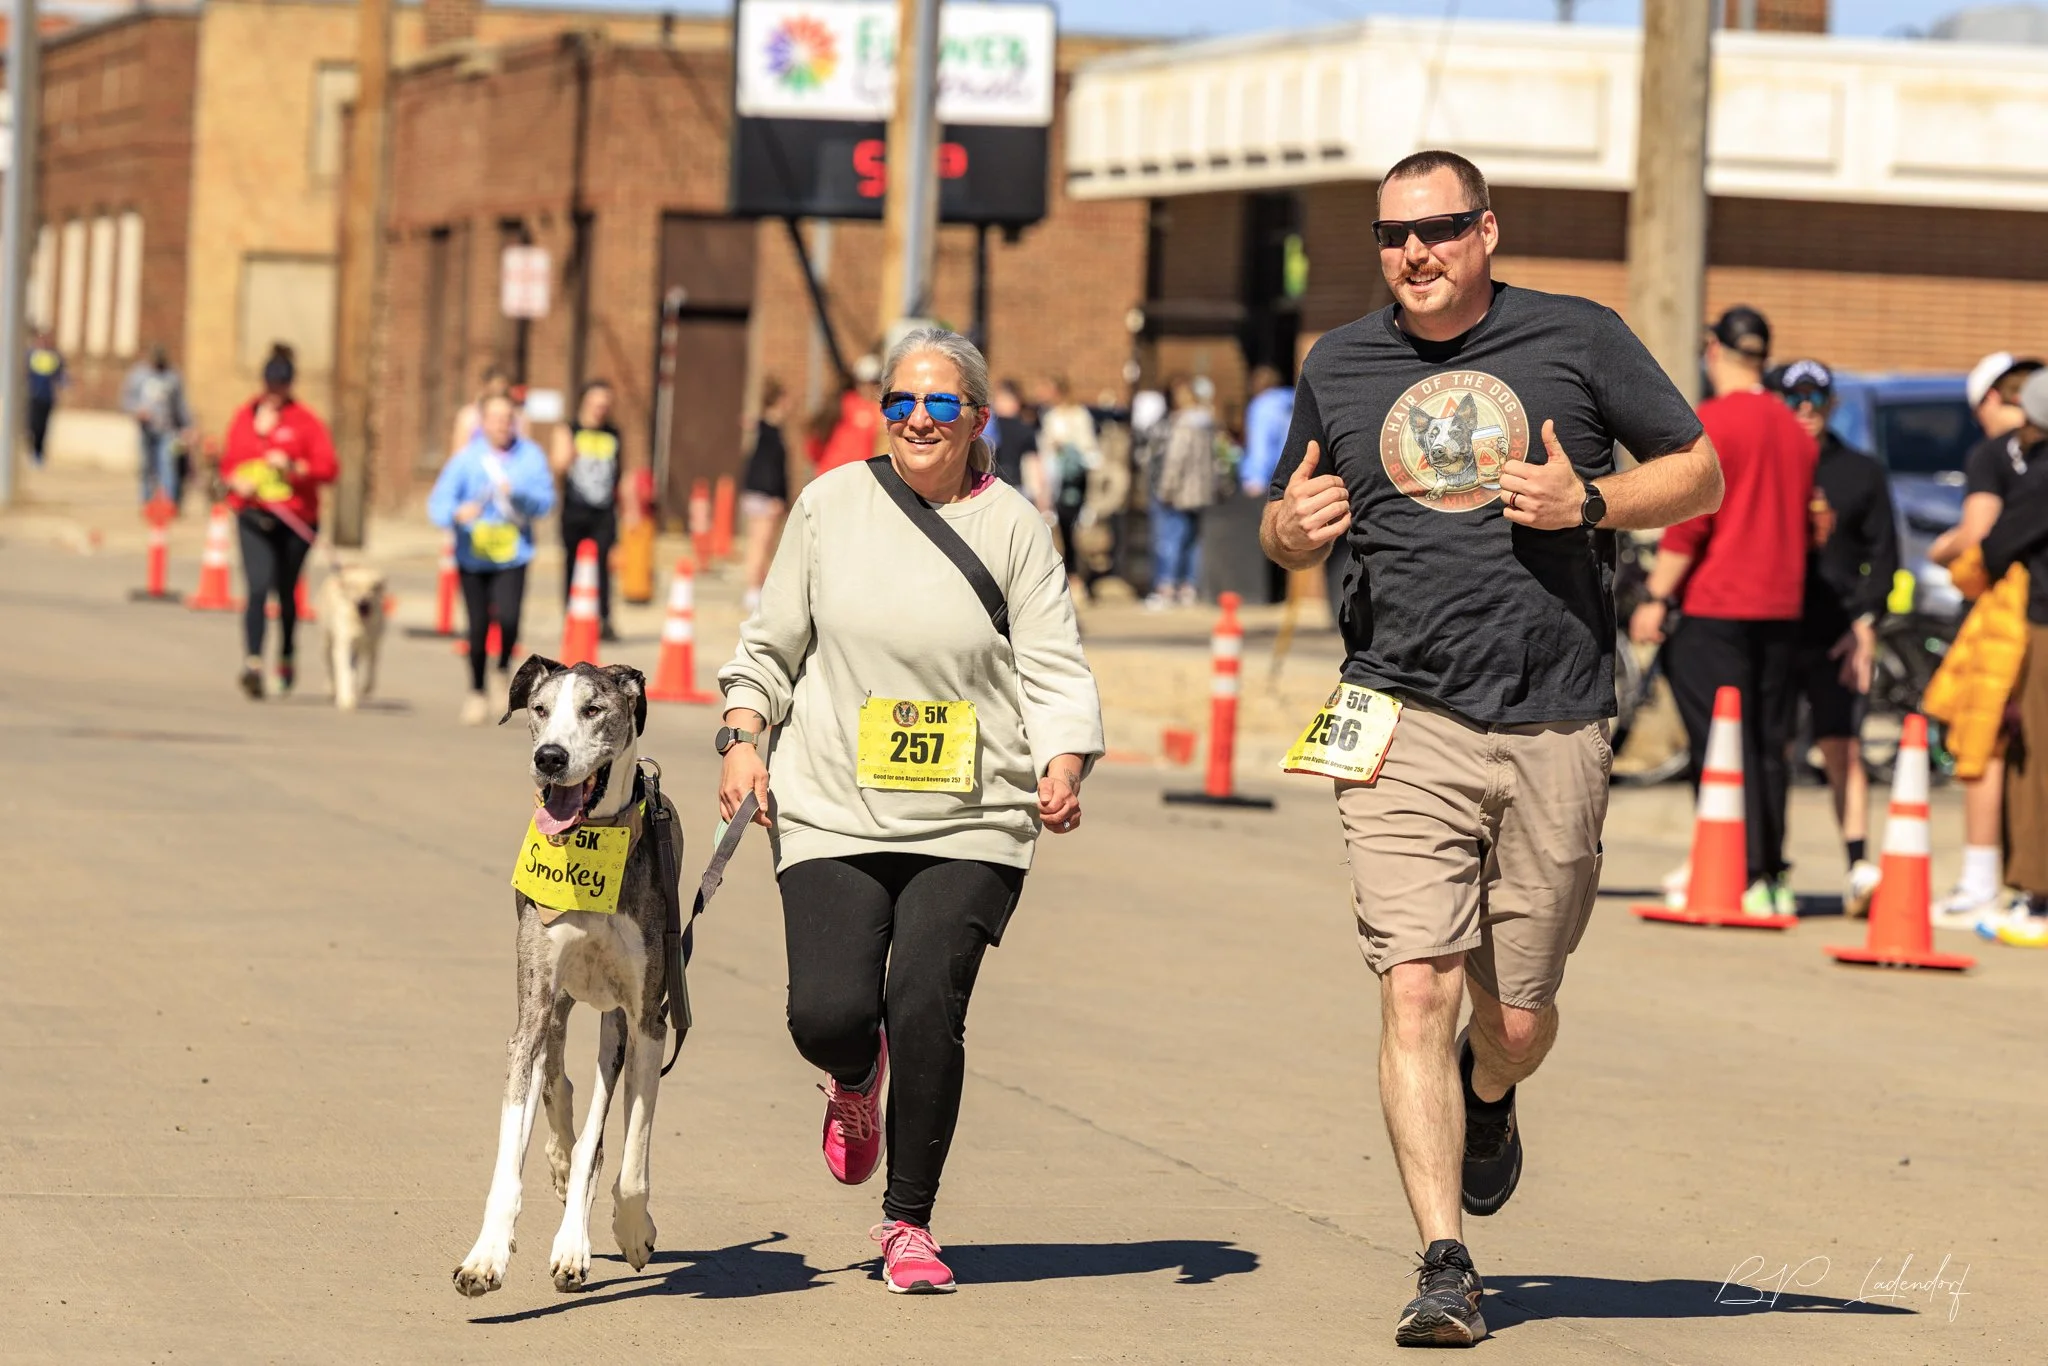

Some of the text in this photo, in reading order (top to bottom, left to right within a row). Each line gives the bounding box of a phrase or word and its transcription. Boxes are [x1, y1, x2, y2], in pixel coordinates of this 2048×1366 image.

[1387, 375, 1517, 433] HAIR OF THE DOG
[1442, 491, 1484, 506] MILE
[1346, 690, 1373, 713] 5K
[924, 706, 948, 724] 5K
[1305, 713, 1362, 751] 256
[890, 731, 944, 764] 257
[575, 830, 601, 850] 5K
